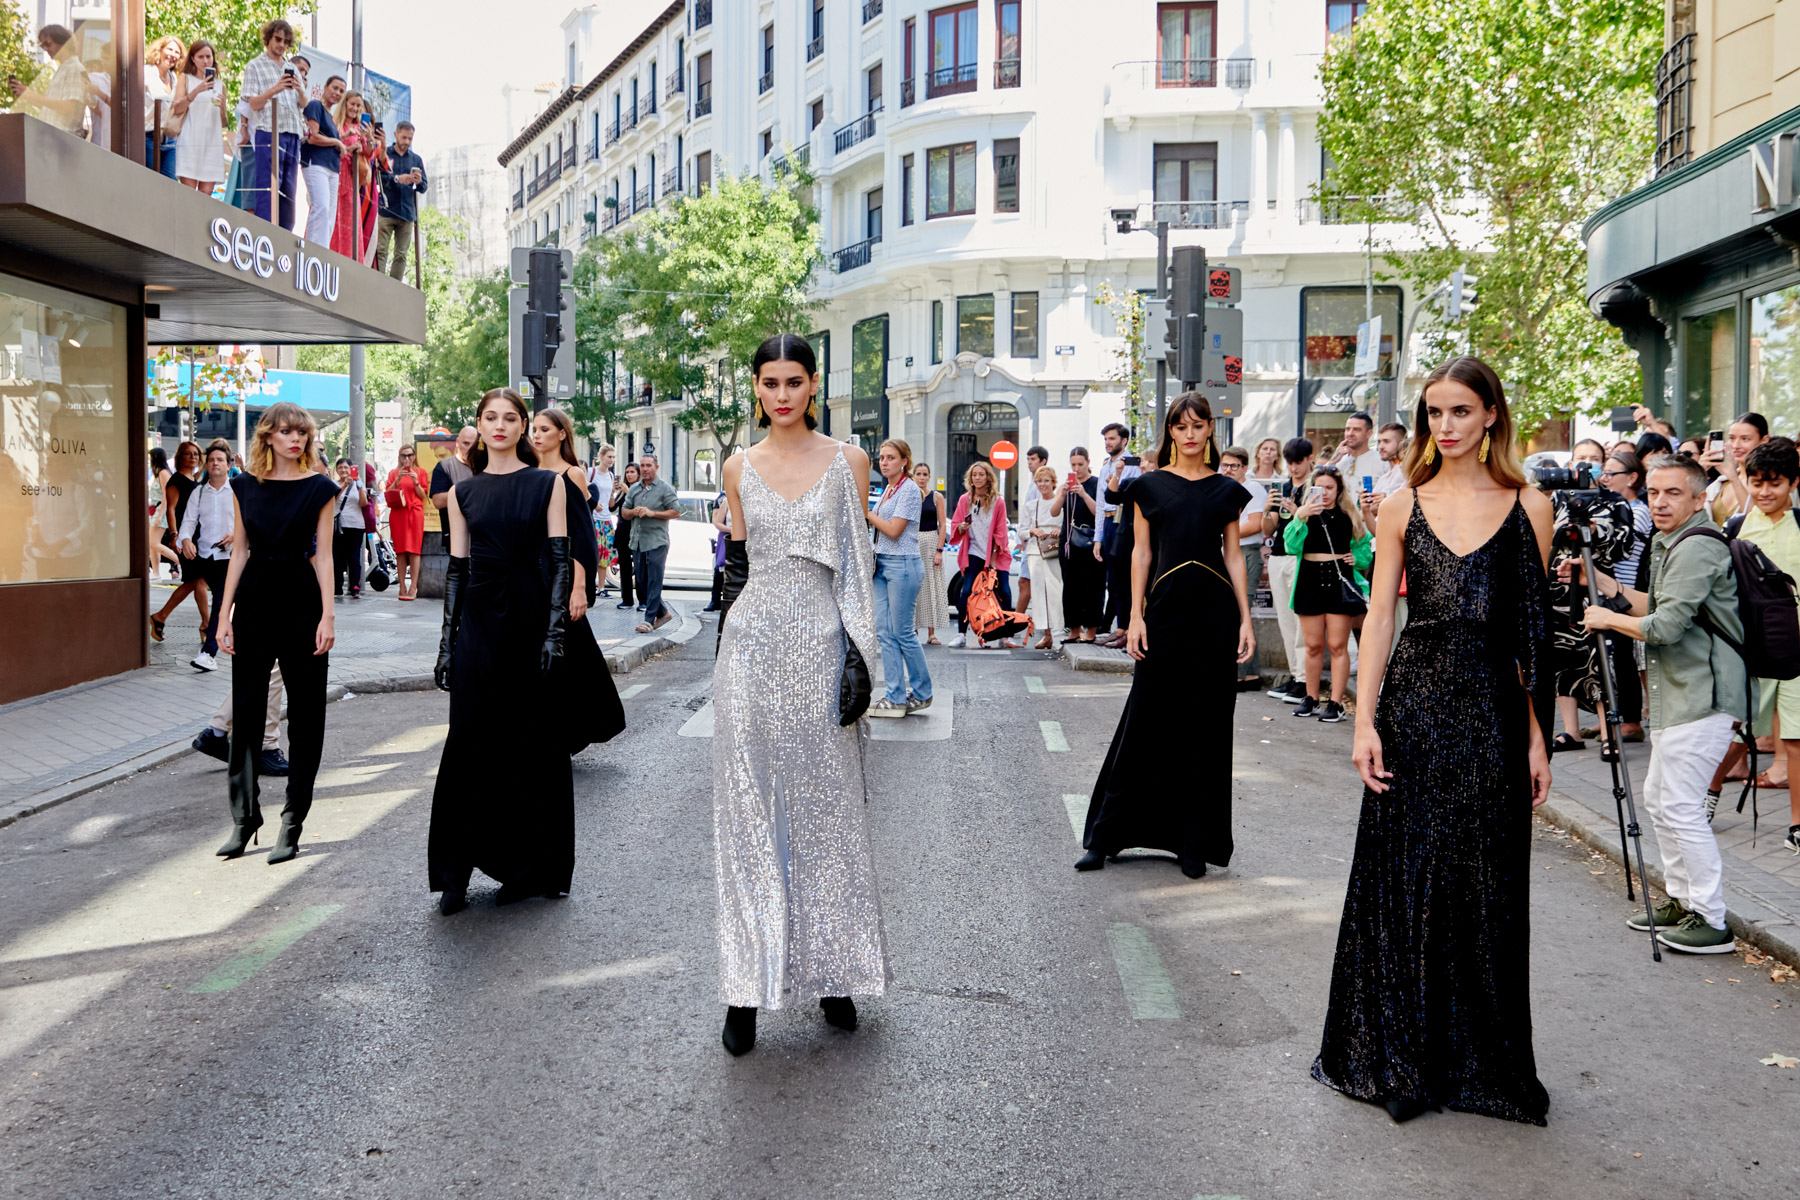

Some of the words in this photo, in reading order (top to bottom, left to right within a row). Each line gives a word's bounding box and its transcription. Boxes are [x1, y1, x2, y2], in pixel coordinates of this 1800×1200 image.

[1747, 131, 1793, 214] N
[858, 409, 879, 421] Santander
[51, 437, 87, 456] OLIVA
